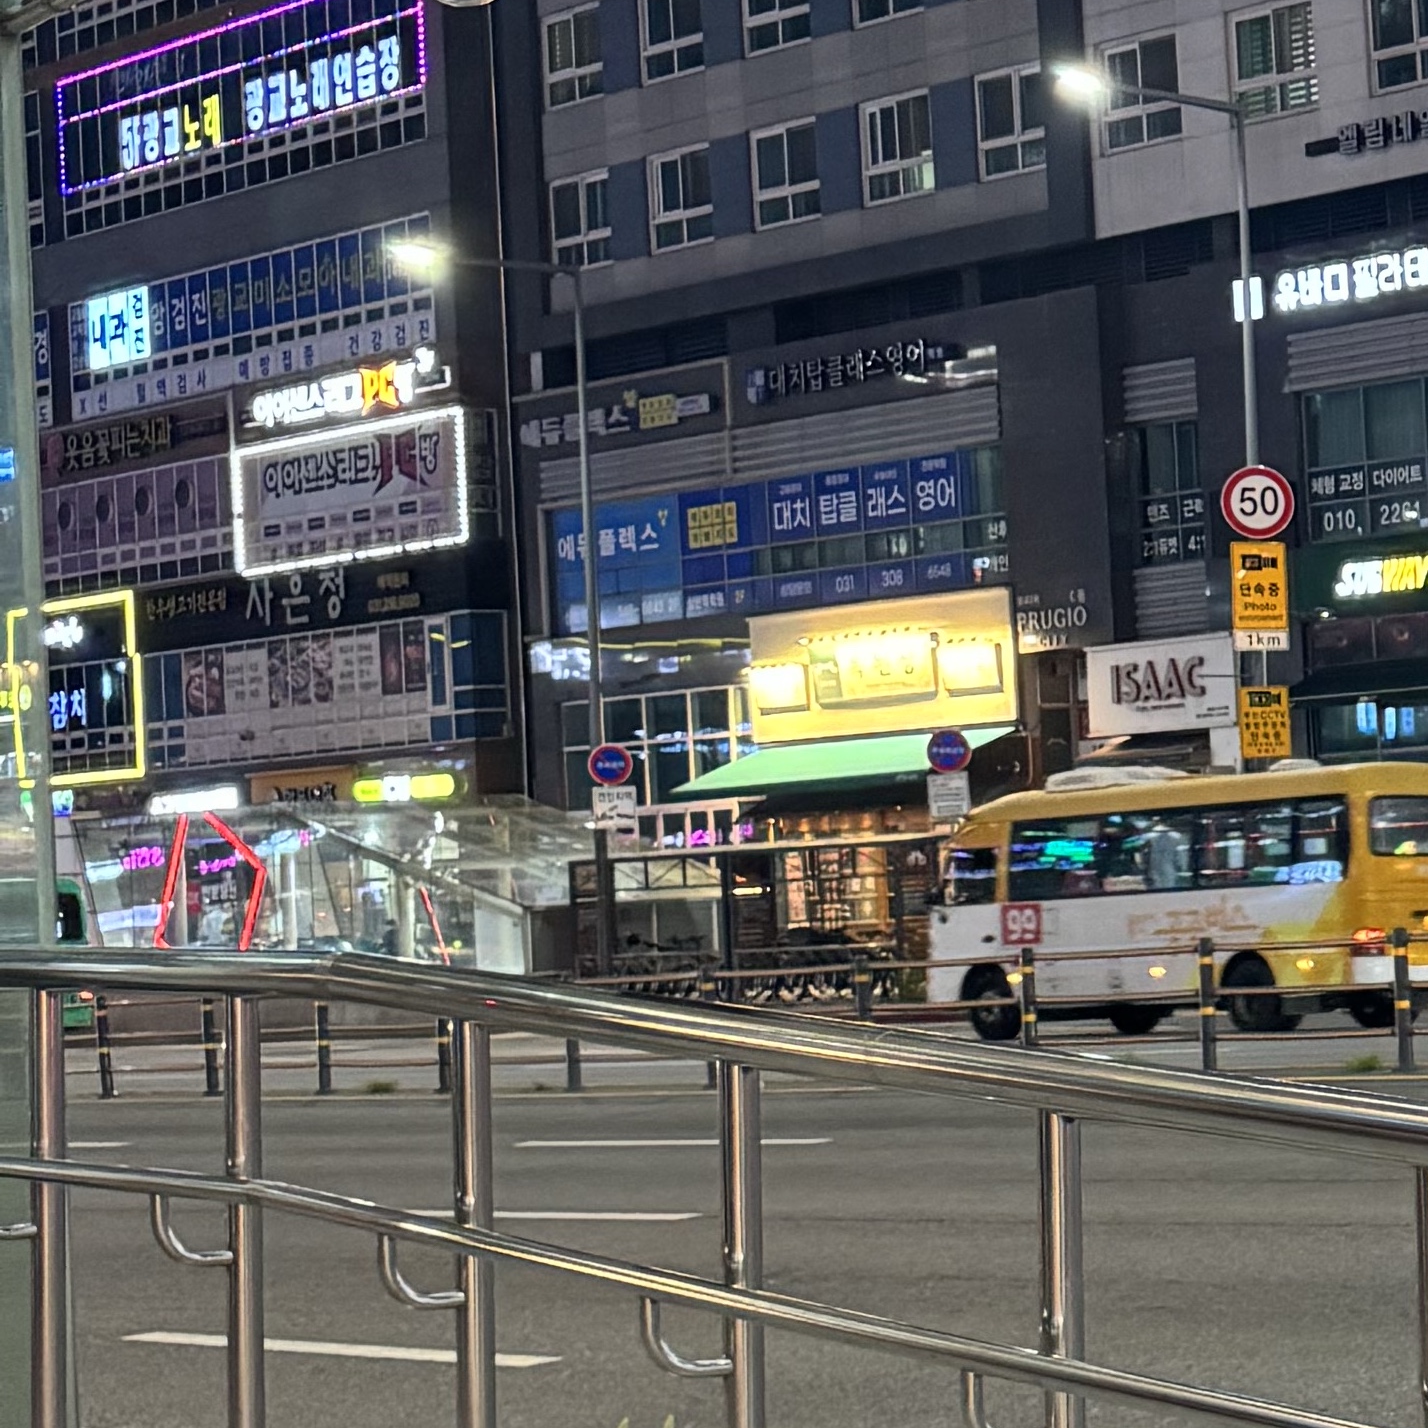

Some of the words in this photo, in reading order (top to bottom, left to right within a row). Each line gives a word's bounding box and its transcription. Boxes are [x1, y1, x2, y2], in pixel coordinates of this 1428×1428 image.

[245, 35, 400, 130] 광교노래연습장
[212, 247, 405, 320] 광교미소모아내과
[1373, 464, 1422, 488] 다이어트
[773, 496, 812, 532] 대치
[866, 483, 907, 519] 래스
[916, 475, 957, 512] 영어
[1239, 485, 1279, 517] 50
[245, 563, 346, 626] 사은정
[836, 575, 855, 594] 031
[1240, 582, 1280, 597] 단속중
[1017, 604, 1088, 633] PRUGIO
[1244, 602, 1277, 611] Photo
[1110, 655, 1207, 704] ISAAC
